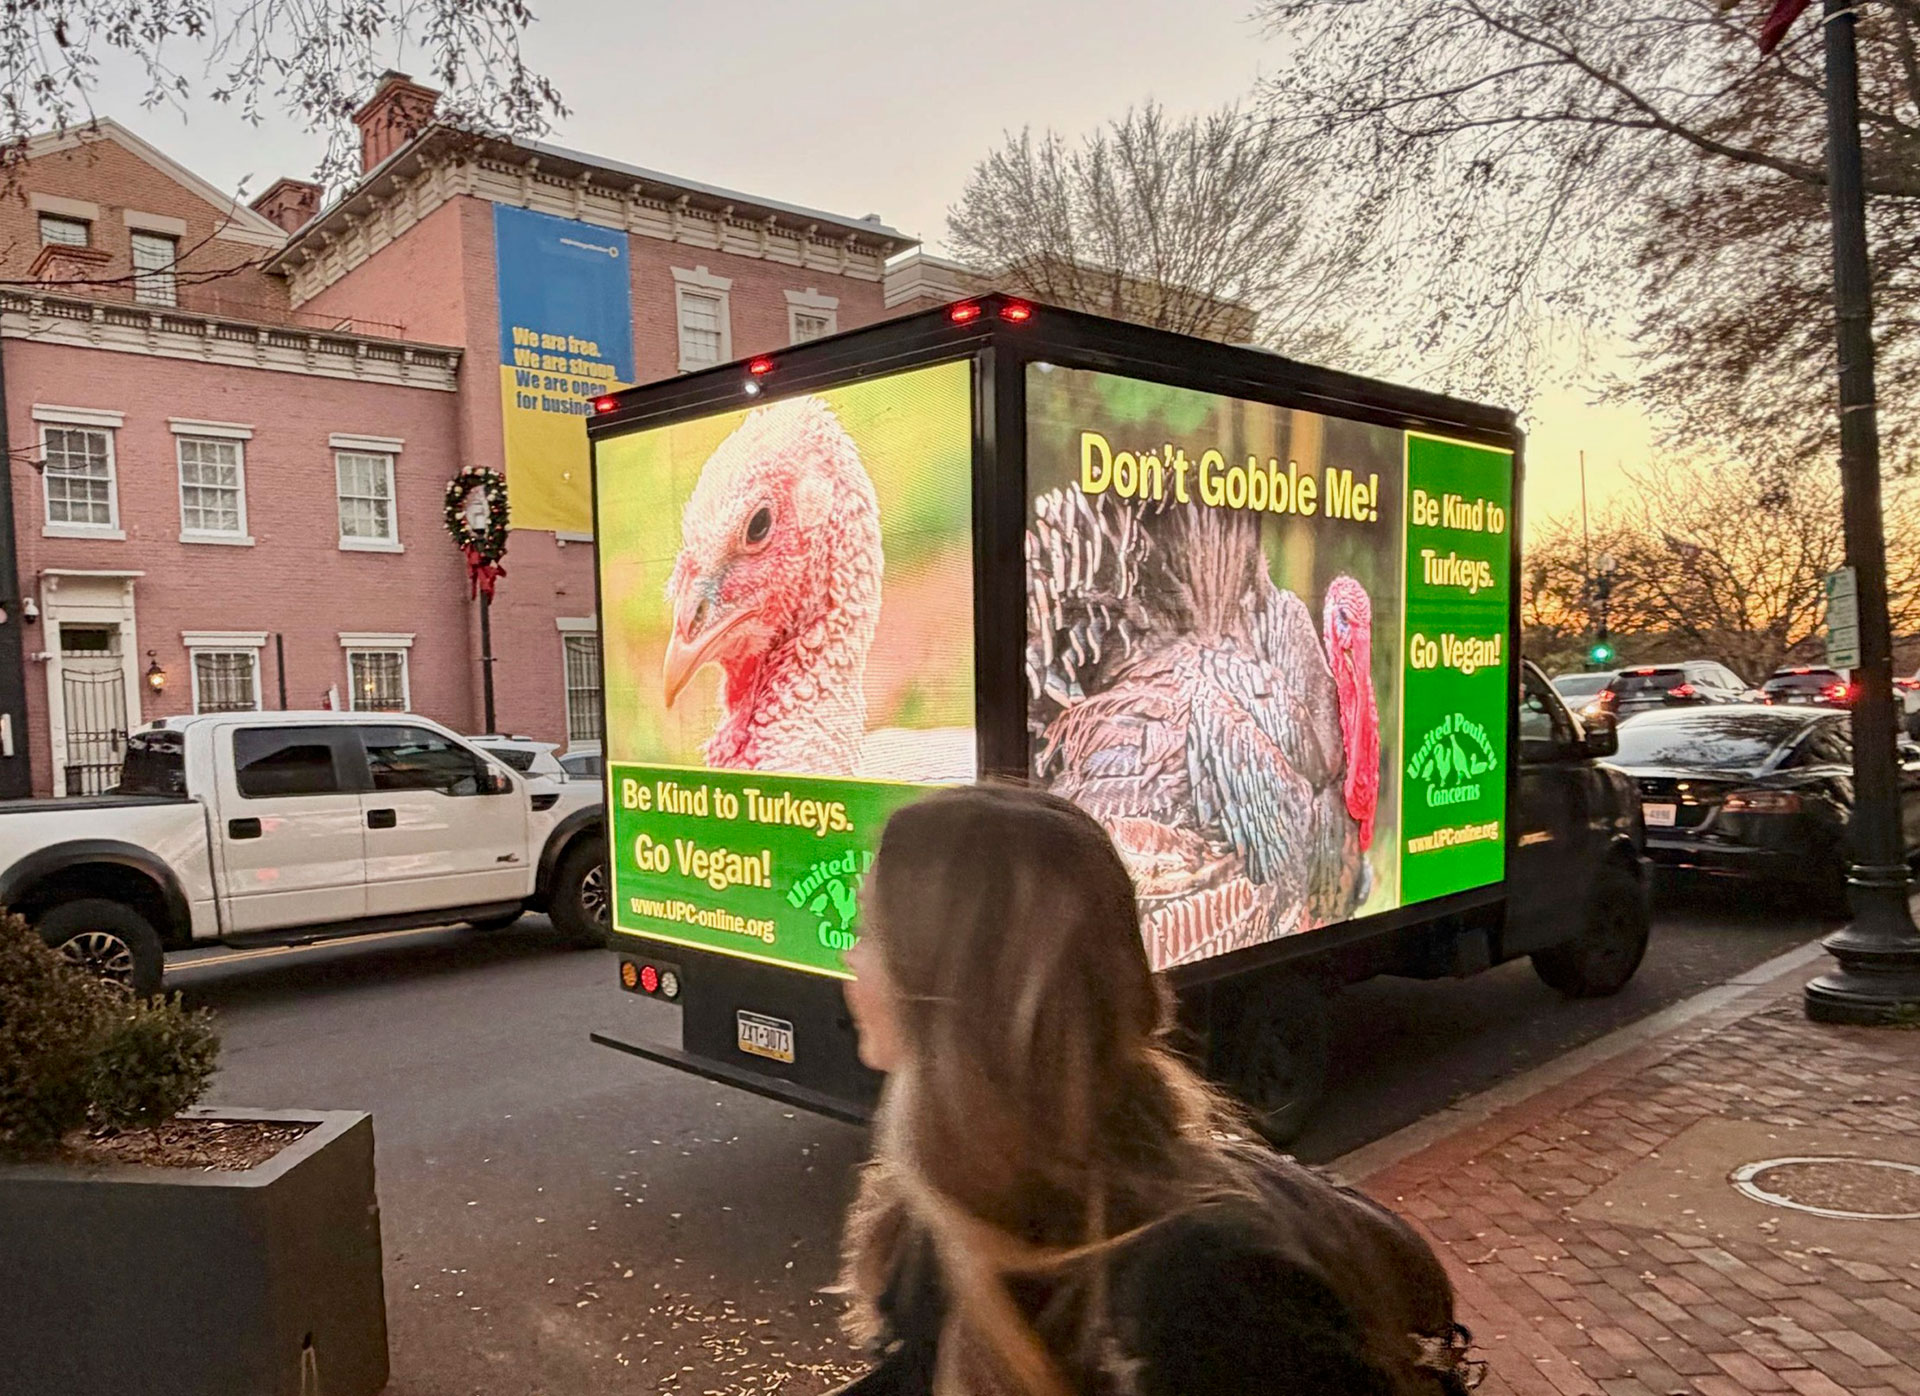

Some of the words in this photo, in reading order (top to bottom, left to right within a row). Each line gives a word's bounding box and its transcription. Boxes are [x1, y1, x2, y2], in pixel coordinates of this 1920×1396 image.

[512, 326, 539, 347] We
[541, 334, 566, 351] are
[568, 335, 602, 357] free.
[513, 347, 540, 368] We
[542, 355, 567, 372] are
[569, 357, 618, 381] strong.
[515, 369, 540, 389] We
[543, 375, 568, 393] are
[572, 380, 607, 397] open
[516, 391, 538, 409] for
[541, 394, 595, 417] busine
[1080, 432, 1190, 504] Don't
[1199, 448, 1318, 516] Gobble
[1325, 467, 1379, 523] Me!
[1412, 489, 1439, 527] Be
[1442, 493, 1484, 533] Kind
[1486, 500, 1506, 534] to
[1420, 549, 1495, 595] Turkeys.
[1410, 633, 1438, 670] Go
[1440, 633, 1501, 676] Vegan!
[1407, 713, 1451, 779] United
[1452, 712, 1498, 772] Poultry
[621, 778, 651, 811] Be
[656, 780, 708, 818] Kind
[713, 787, 739, 821] to
[743, 788, 855, 837] Turkeys.
[1426, 781, 1481, 808] Concerns
[634, 833, 670, 874] Go
[675, 838, 772, 891] Vegan!
[786, 849, 857, 909] United
[630, 896, 776, 944] www.UPC-online.org
